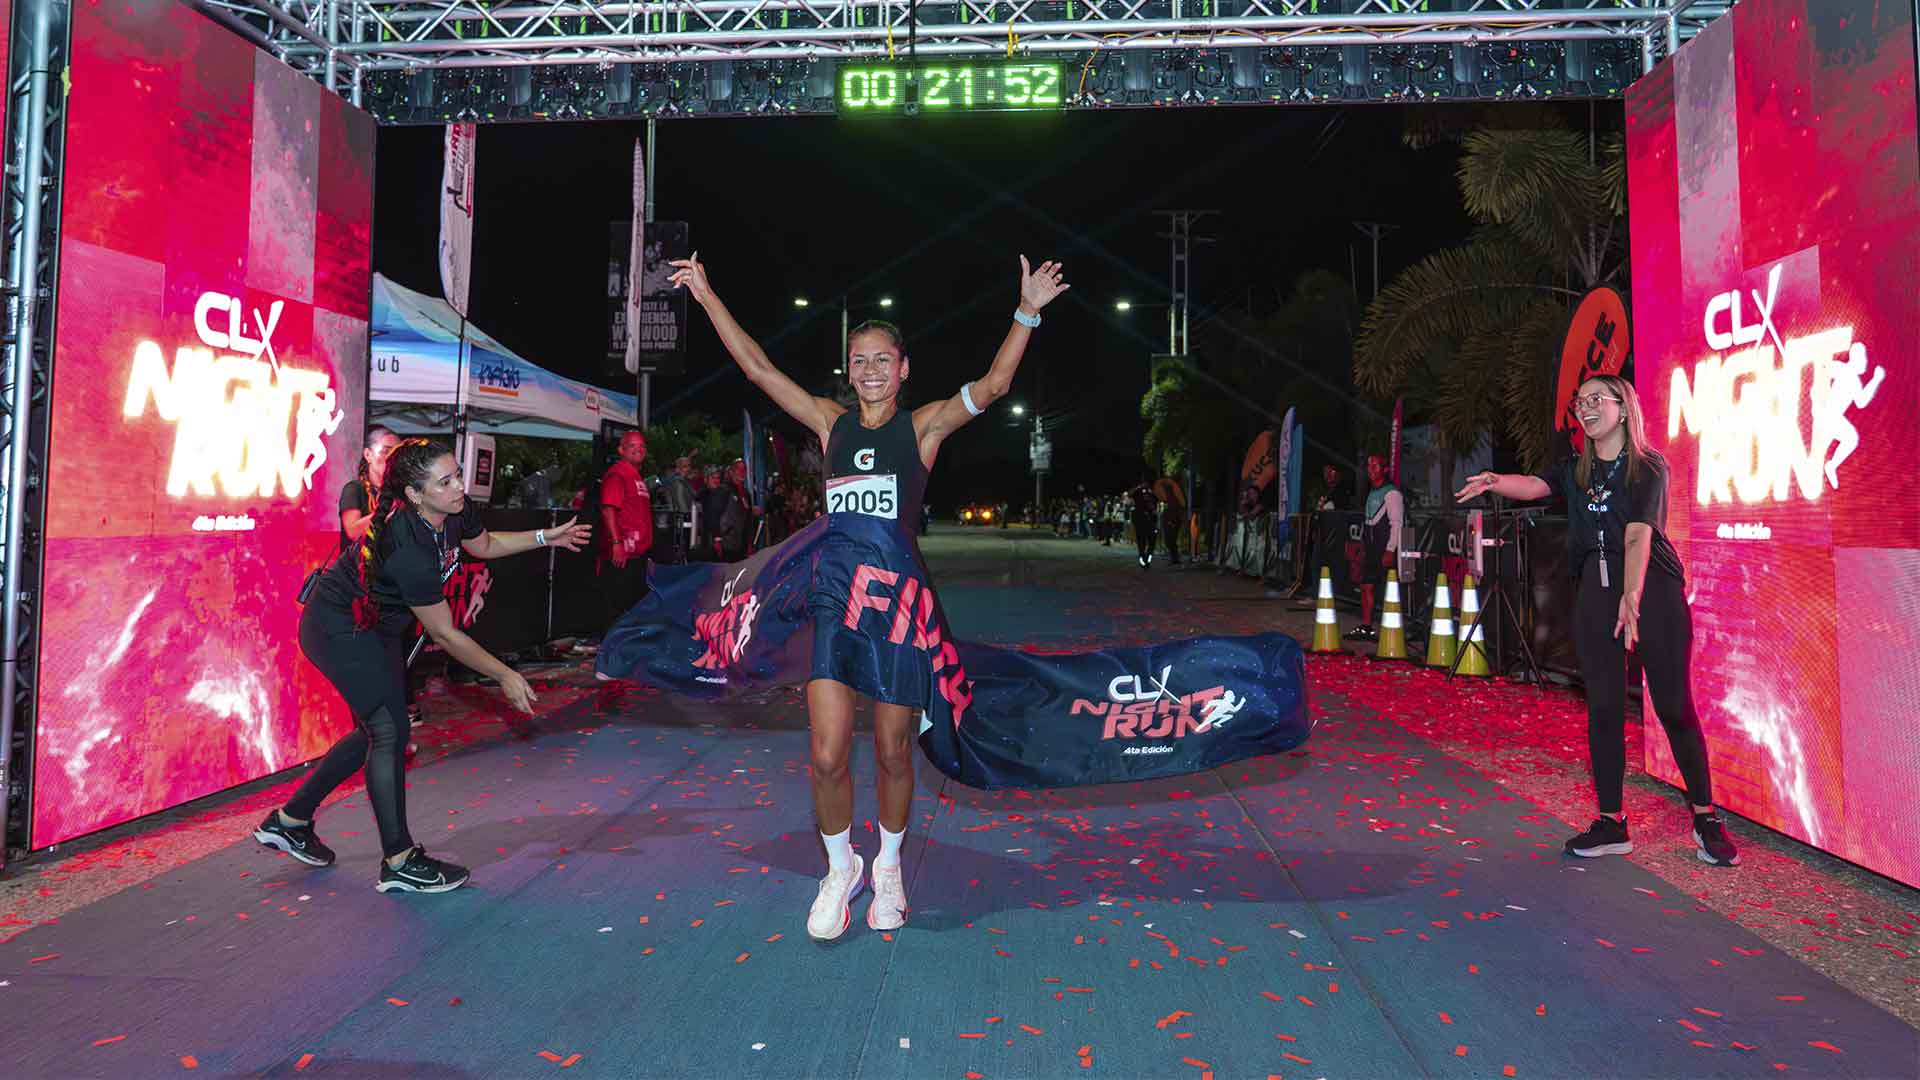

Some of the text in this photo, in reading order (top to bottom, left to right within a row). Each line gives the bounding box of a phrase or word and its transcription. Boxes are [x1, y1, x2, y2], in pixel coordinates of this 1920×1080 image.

[844, 65, 1059, 106] 00:21:52
[1704, 263, 1785, 358] CLX
[194, 291, 285, 378] CLX
[612, 325, 678, 340] WWOOD
[124, 340, 330, 432] NIGHT
[1668, 327, 1853, 438] NIGHT
[166, 418, 306, 498] RUN
[854, 448, 875, 471] G
[1697, 420, 1827, 504] RUN
[831, 490, 894, 513] 2005
[1071, 686, 1224, 717] NIGHT
[1108, 664, 1182, 704] CLX
[1103, 712, 1212, 740] RUN
[1124, 744, 1174, 755] 4ta Edición
